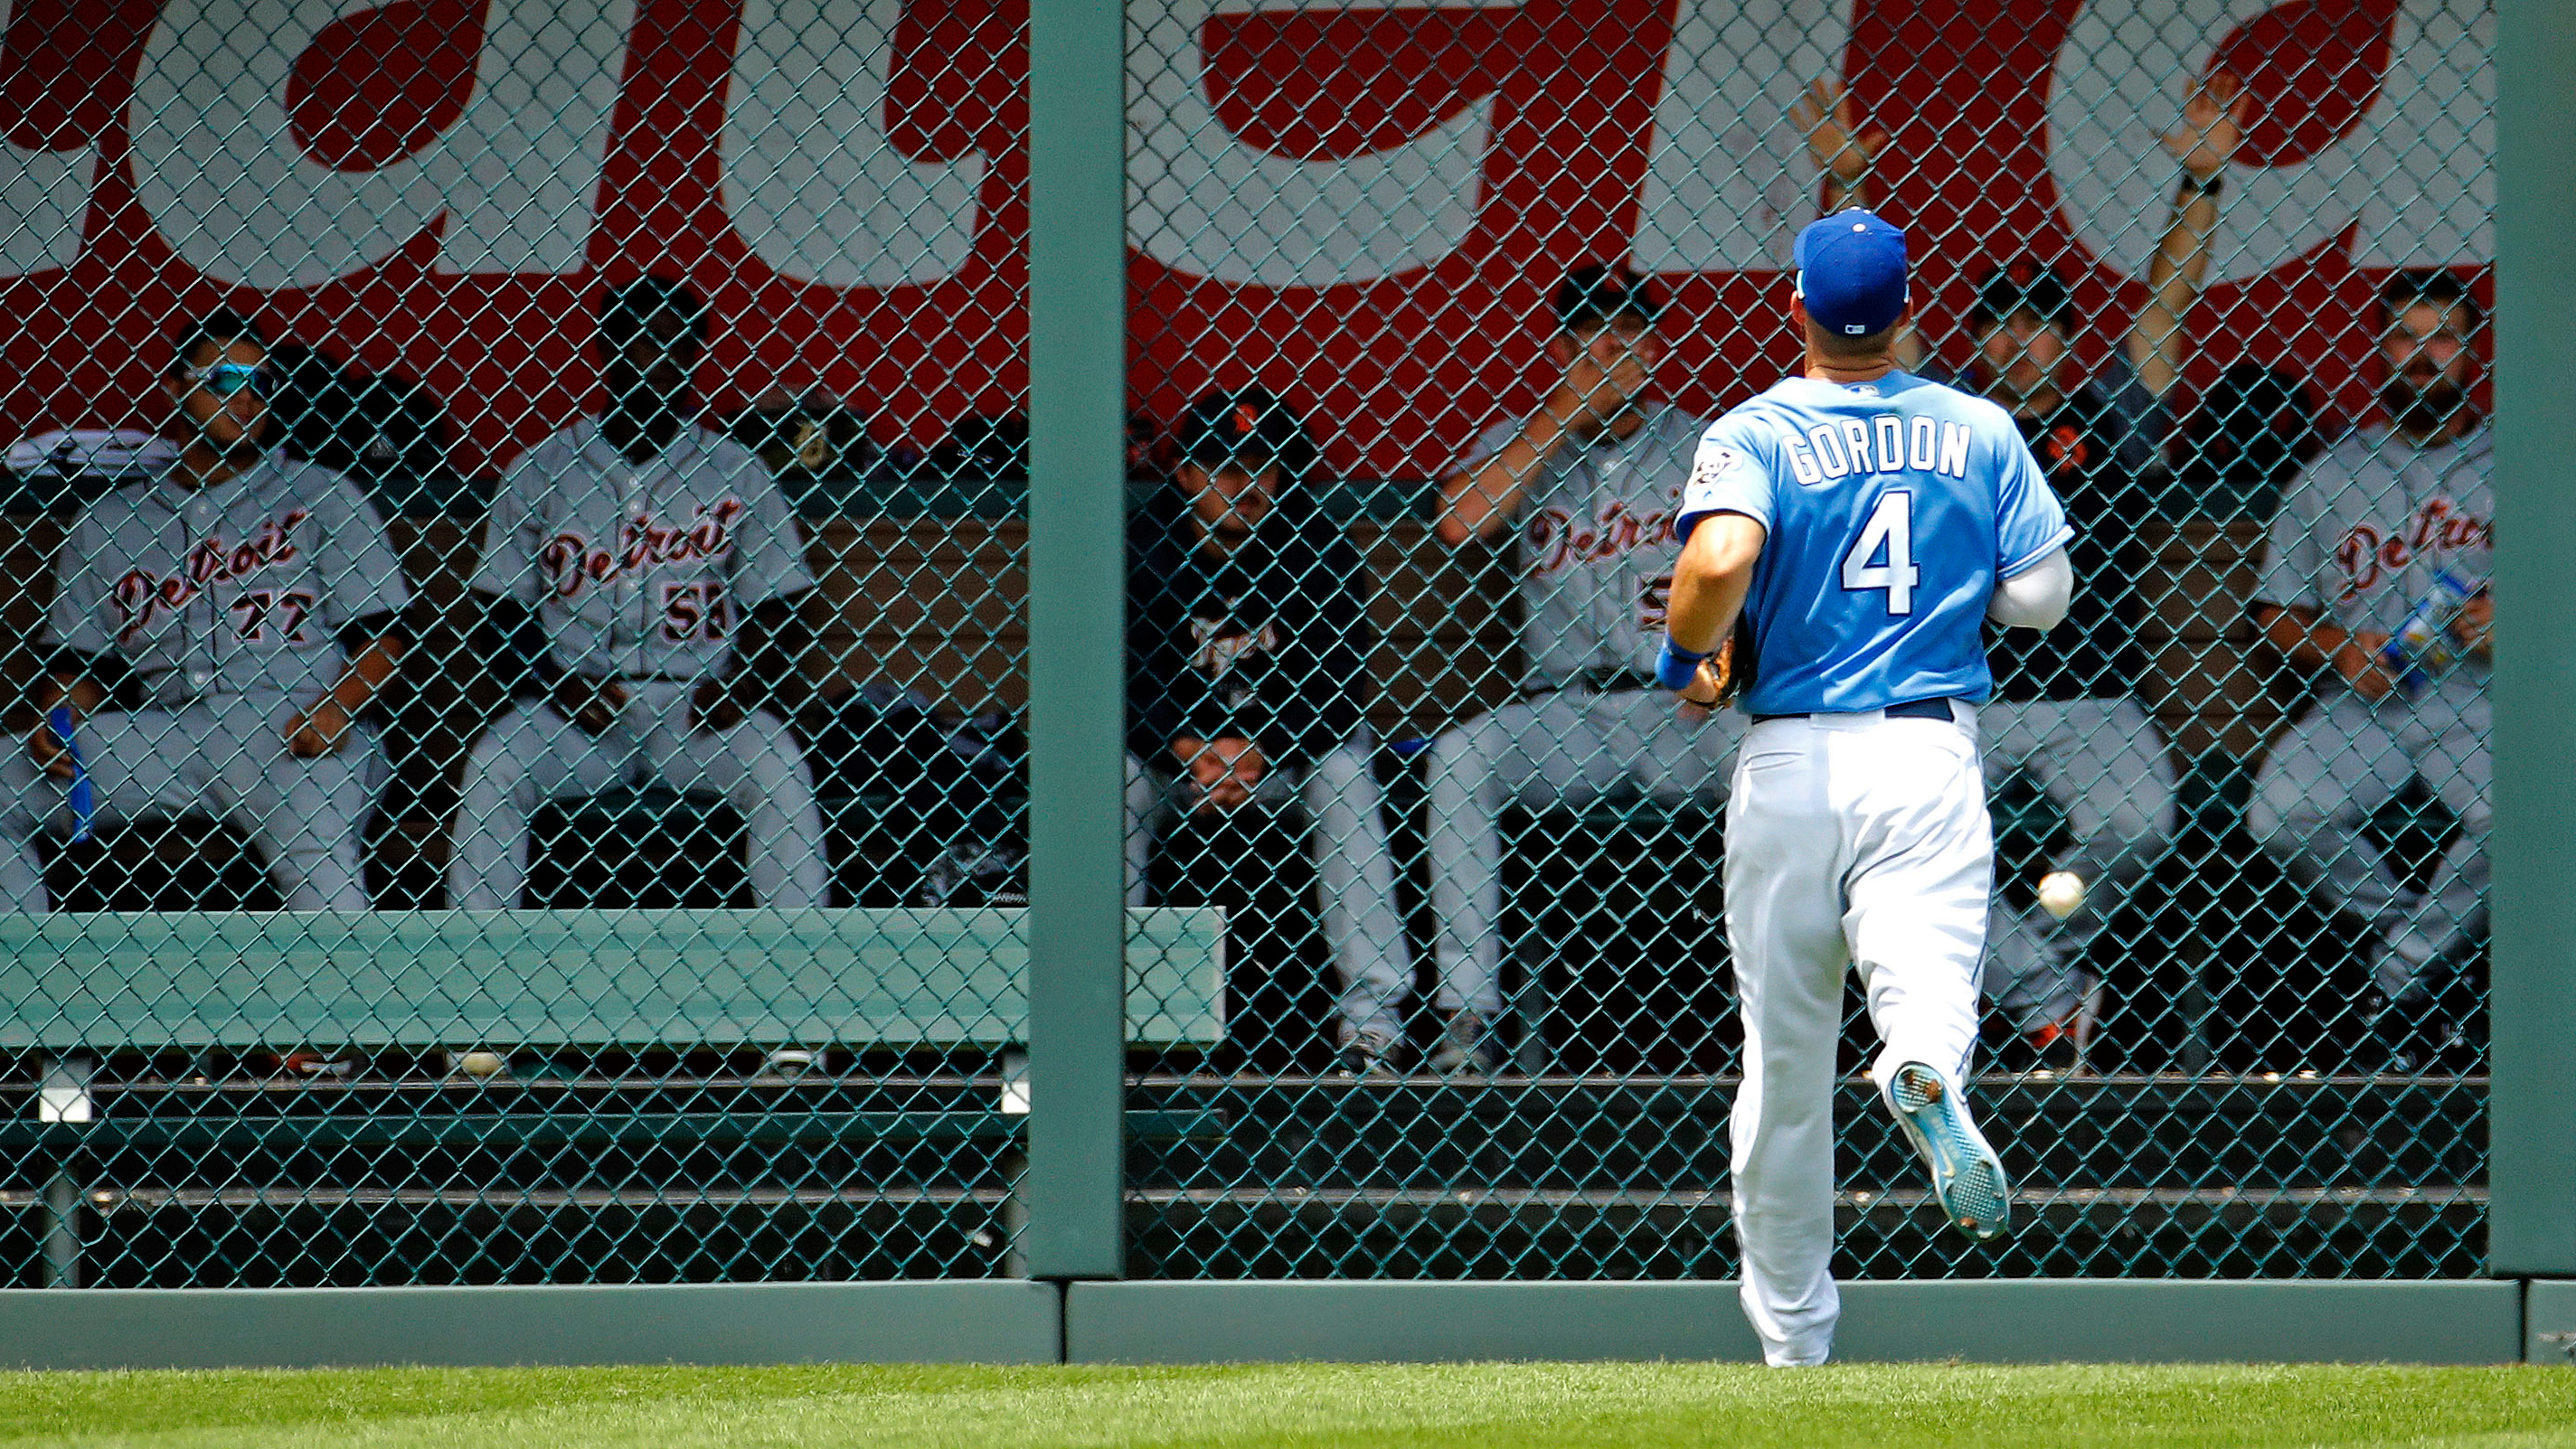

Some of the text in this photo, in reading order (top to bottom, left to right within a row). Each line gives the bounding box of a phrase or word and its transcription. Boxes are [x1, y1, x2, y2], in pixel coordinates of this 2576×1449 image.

[1781, 413, 1974, 486] GORDON
[110, 506, 307, 646] Detroit
[540, 497, 745, 604] Detroit
[1523, 482, 1685, 579] Detroi
[1839, 489, 1920, 617] 4
[231, 588, 314, 643] 77
